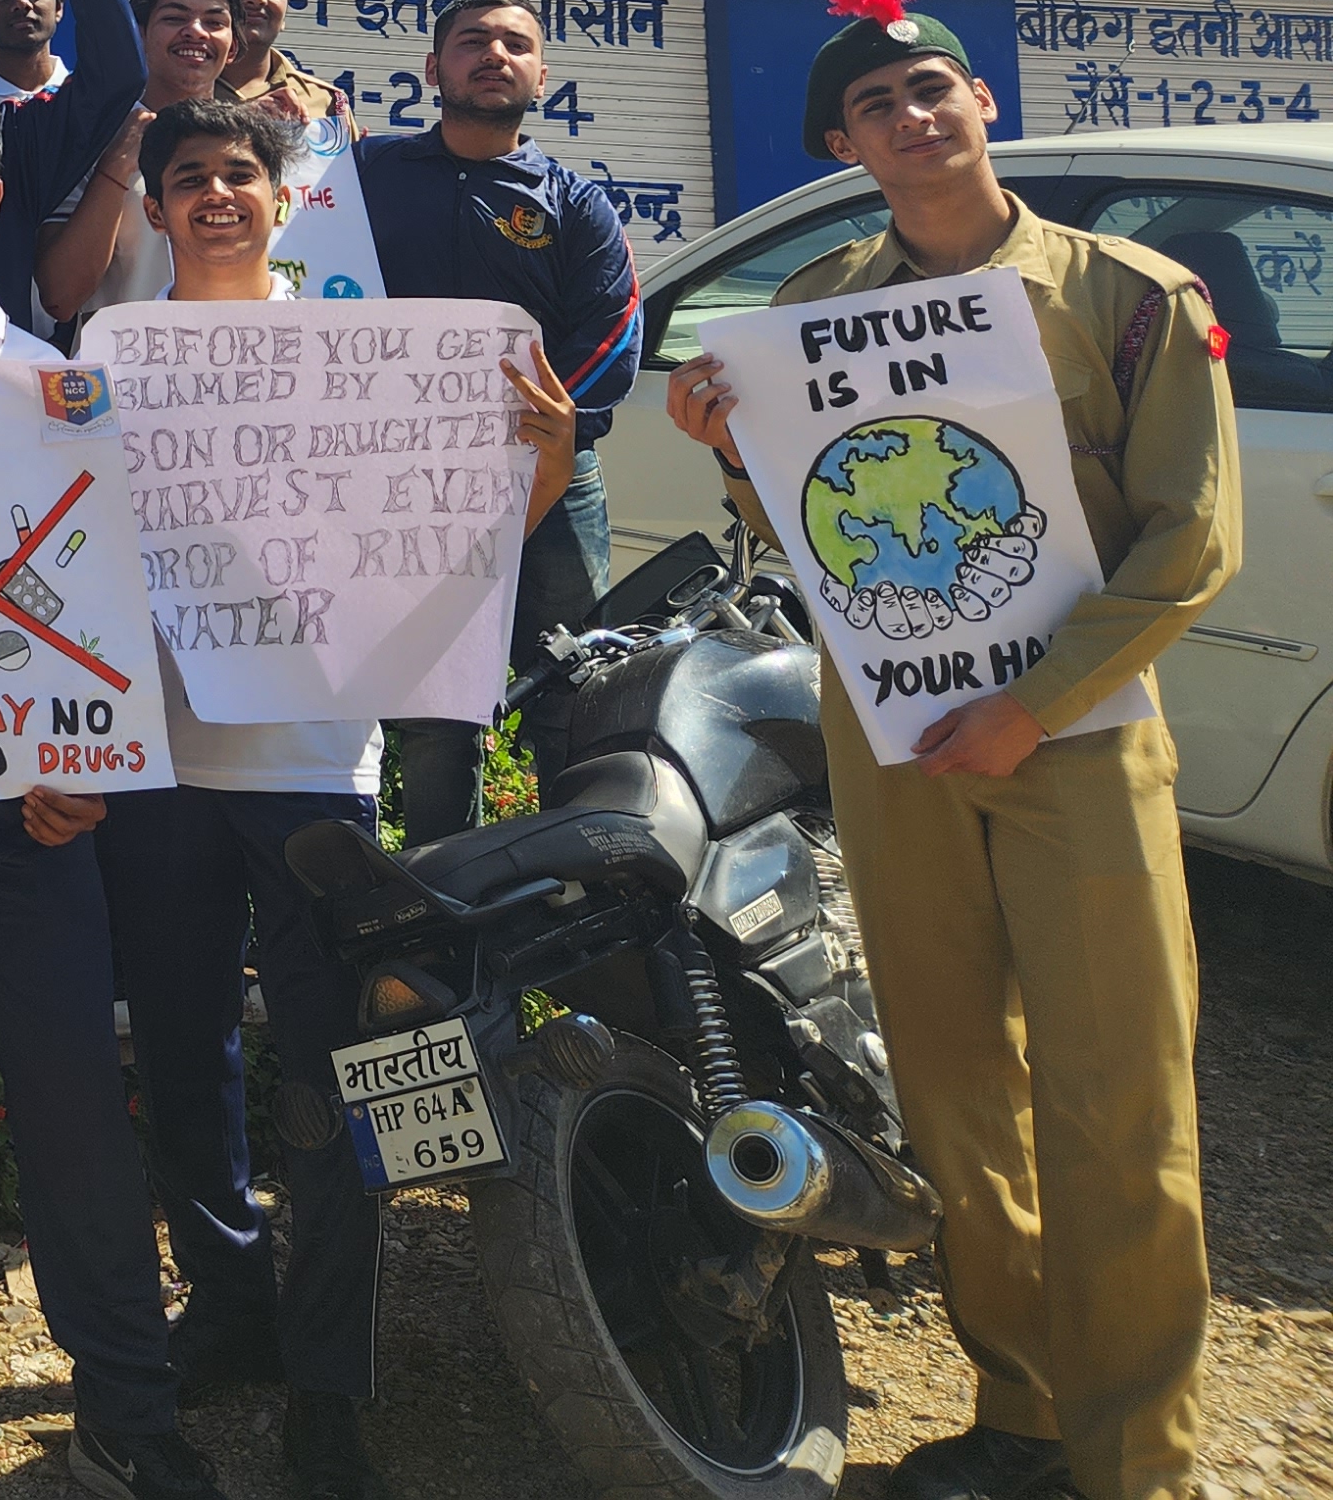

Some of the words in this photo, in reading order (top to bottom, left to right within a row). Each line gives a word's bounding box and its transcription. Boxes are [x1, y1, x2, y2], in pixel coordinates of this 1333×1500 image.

[1250, 8, 1333, 62] आसा
[294, 184, 336, 211] THE
[110, 324, 303, 369] BEFORE
[316, 327, 414, 366] YOU
[437, 327, 533, 361] GET
[800, 294, 993, 364] FUTURE
[114, 368, 297, 411] BLAMED
[319, 371, 379, 402] BY
[806, 370, 859, 412] IS
[888, 352, 948, 396] IN
[122, 426, 218, 474] SON
[233, 424, 298, 467] OR
[131, 467, 353, 532] HARVEST
[381, 463, 532, 516] EVERY
[258, 530, 319, 586] OF
[350, 522, 501, 580] RAIN
[150, 587, 336, 652] WATER
[862, 650, 983, 707] YOUR
[51, 698, 113, 735] NO
[37, 741, 146, 774] DRUGS
[344, 1029, 467, 1093] भारतीय
[371, 1102, 405, 1134] HP
[414, 1129, 485, 1169] 659
